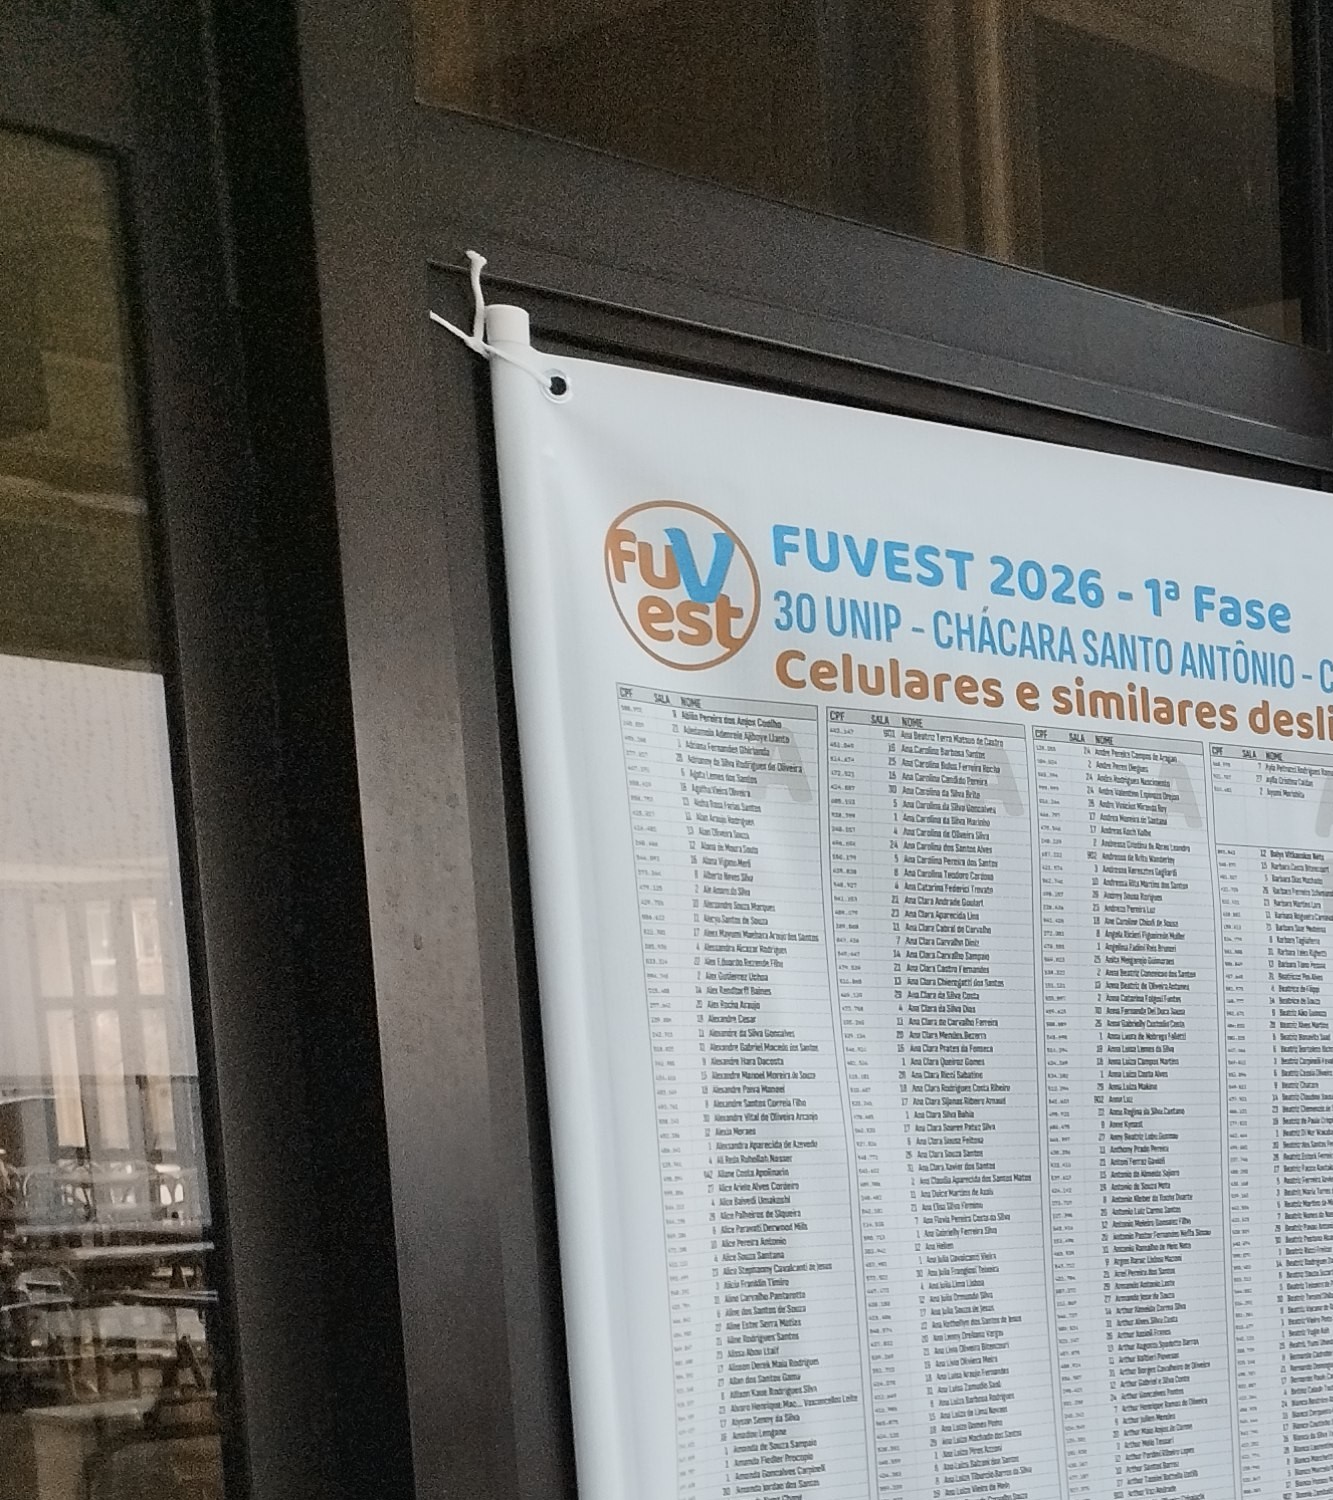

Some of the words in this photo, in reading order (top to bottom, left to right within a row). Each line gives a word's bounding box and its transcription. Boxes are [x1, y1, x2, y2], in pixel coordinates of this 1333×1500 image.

[771, 525, 974, 590] FUVEST
[990, 556, 1103, 608] 2026
[1144, 579, 1179, 616] 1ª
[1194, 586, 1290, 633] Fase
[775, 591, 816, 633] 30
[826, 597, 901, 640] UNIP
[933, 605, 1075, 663] CHÁCARA
[1082, 629, 1171, 674] SANTO
[1180, 639, 1294, 688] ANTÔNIO
[776, 651, 1003, 707] Celulares
[1016, 683, 1038, 710] e
[1053, 680, 1237, 731] similares
[830, 711, 845, 721] CPF
[871, 715, 889, 725] SALA
[901, 718, 923, 728] NOME
